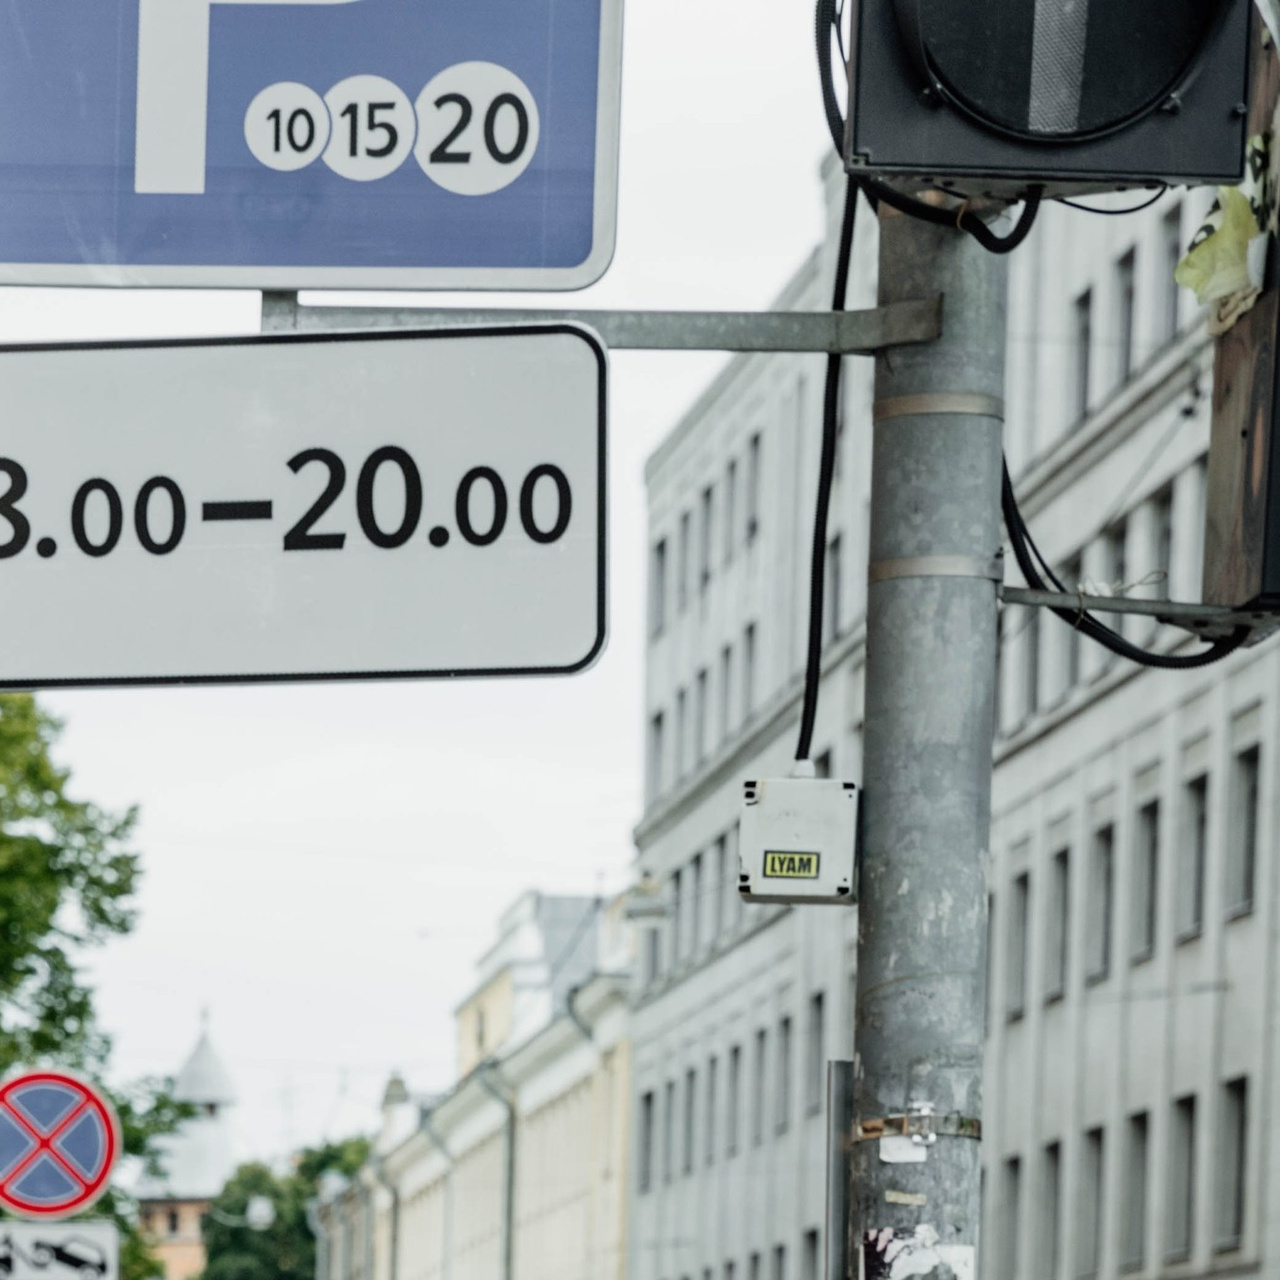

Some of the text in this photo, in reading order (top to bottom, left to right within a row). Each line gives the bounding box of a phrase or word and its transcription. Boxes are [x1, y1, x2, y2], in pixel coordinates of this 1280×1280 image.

[265, 91, 530, 165] 10 15 20
[770, 855, 813, 874] LYAM
